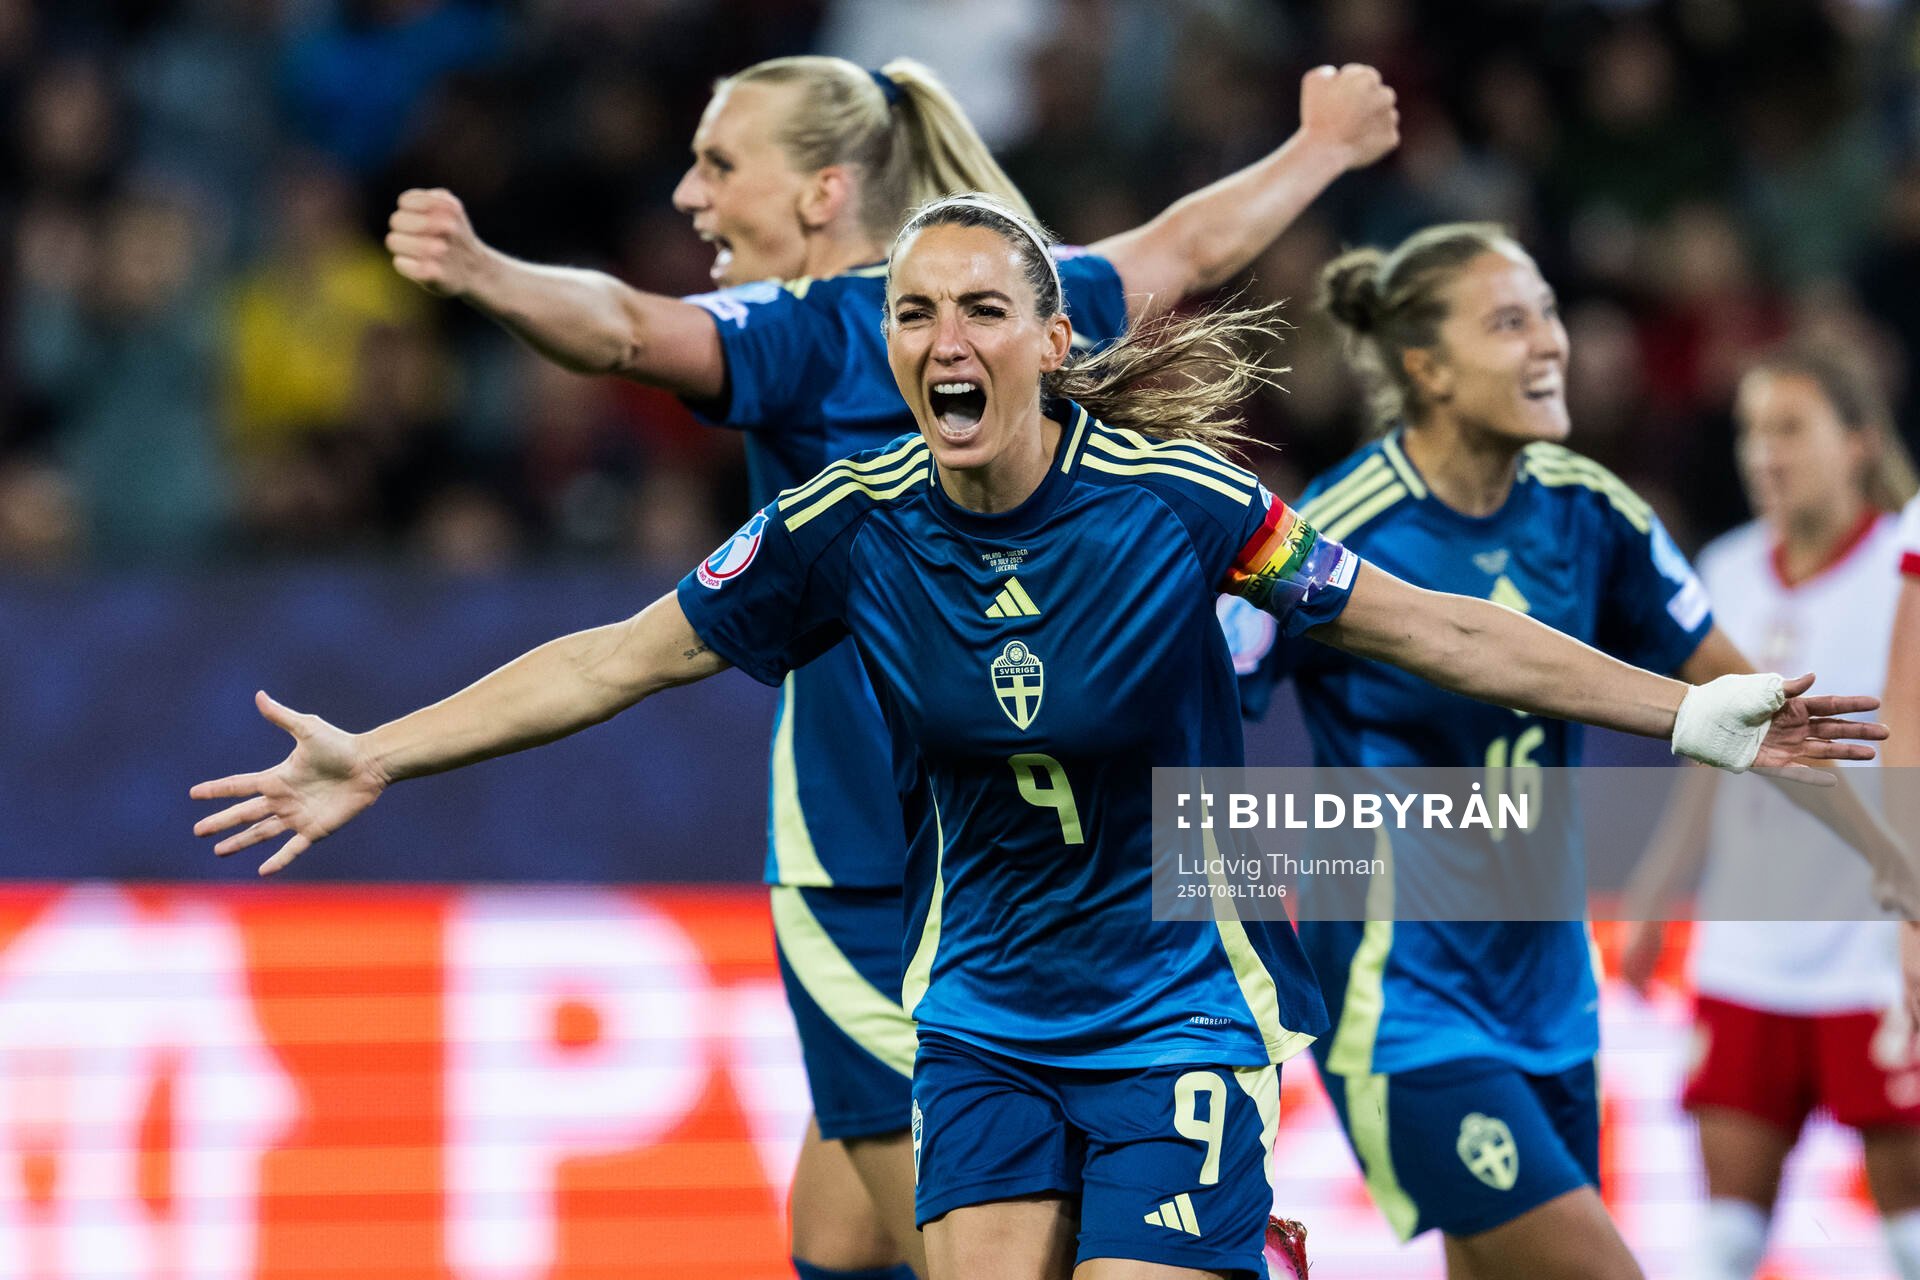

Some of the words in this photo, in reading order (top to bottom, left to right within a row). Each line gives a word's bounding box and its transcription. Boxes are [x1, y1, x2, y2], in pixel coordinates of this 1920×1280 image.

[998, 557, 1009, 565] JULY
[1010, 556, 1023, 564] 2025
[995, 563, 1018, 573] LUCERNE
[705, 578, 720, 587] 2025
[999, 666, 1035, 676] SVERIGE
[1485, 724, 1544, 842] 16
[1007, 753, 1085, 845] 9
[1190, 1016, 1232, 1025] AEROREADY
[1173, 1070, 1228, 1186] 9
